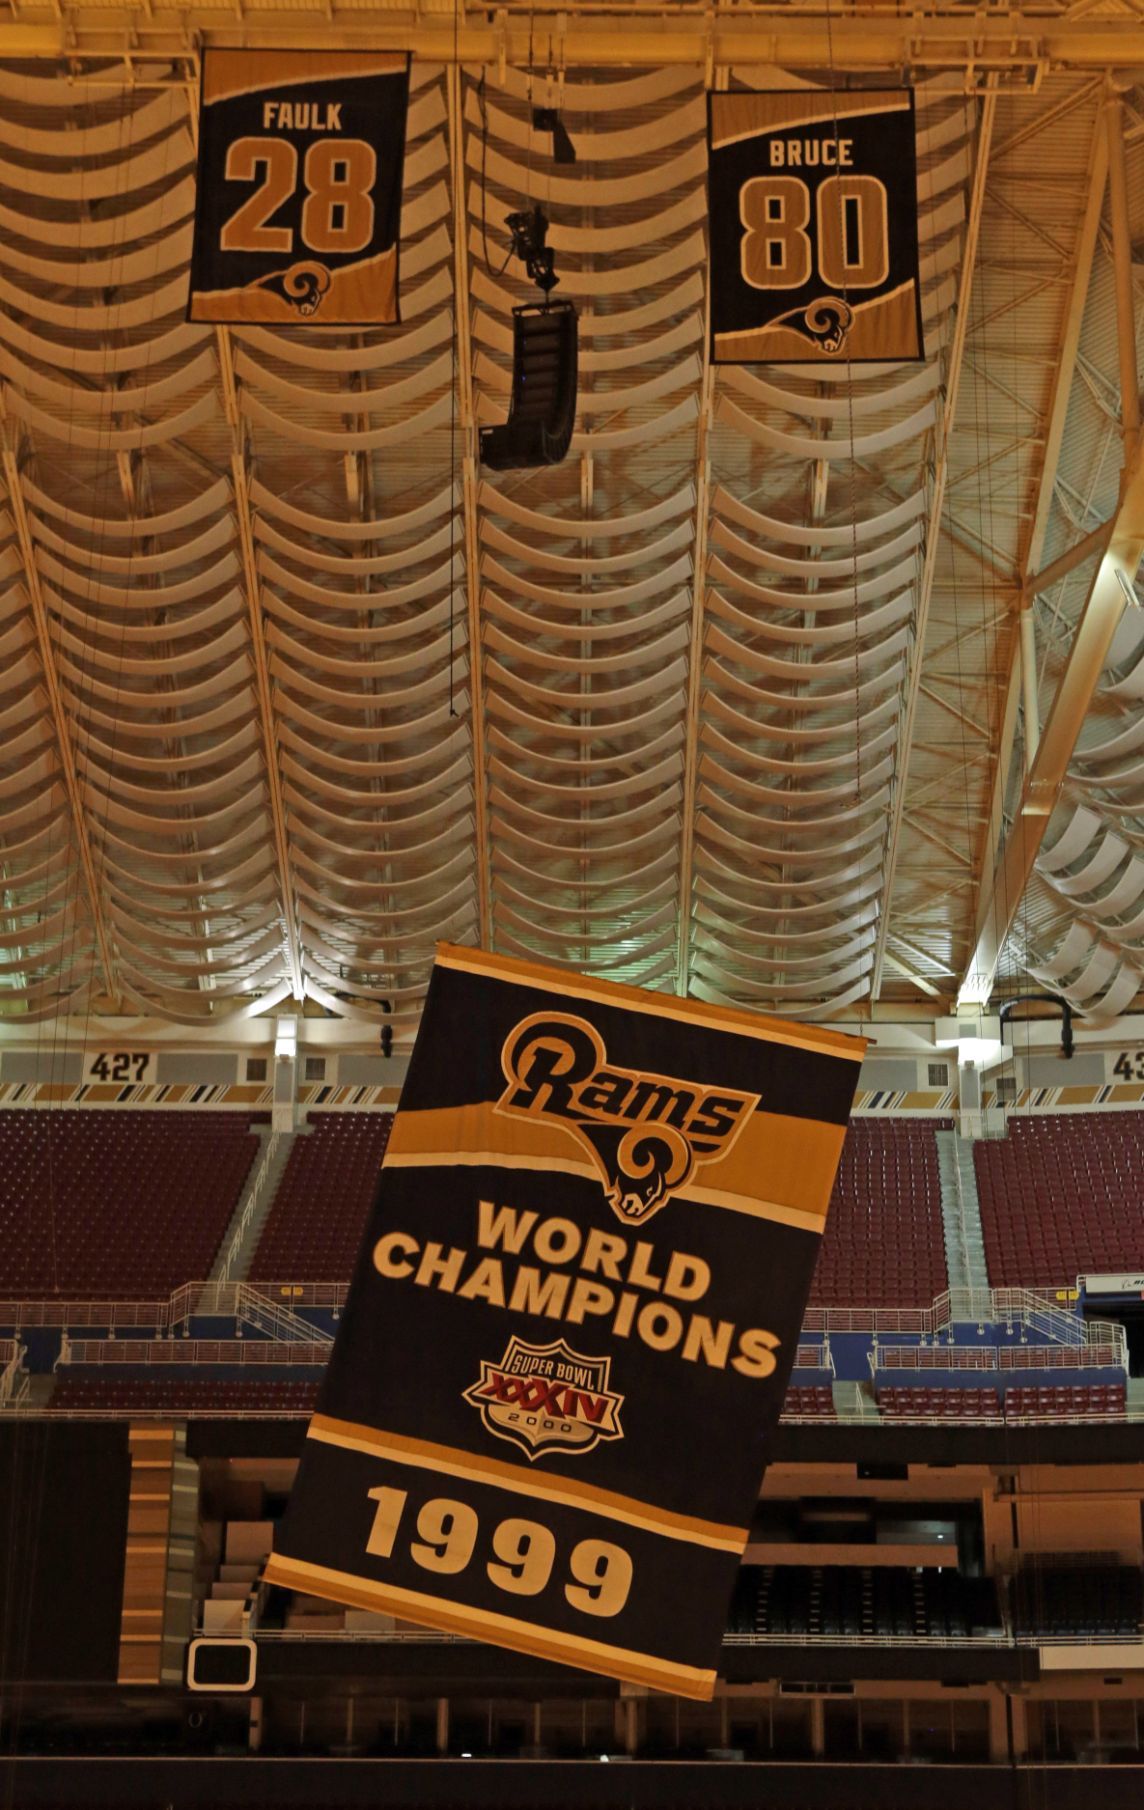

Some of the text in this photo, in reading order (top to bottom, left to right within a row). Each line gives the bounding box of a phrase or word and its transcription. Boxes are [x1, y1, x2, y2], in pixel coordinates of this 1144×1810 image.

[263, 102, 342, 131] FAULK
[770, 139, 854, 167] BRUCE
[220, 136, 377, 254] 28
[739, 174, 890, 291] 80
[90, 1053, 150, 1082] 427
[504, 1018, 750, 1140] Rams
[476, 1199, 711, 1302] WORLD
[372, 1231, 783, 1379] CHAMPIONS
[478, 1371, 610, 1424] XXXIV
[511, 1354, 595, 1390] SUPER BOWL
[507, 1412, 572, 1433] 2000
[365, 1485, 634, 1618] 1999
